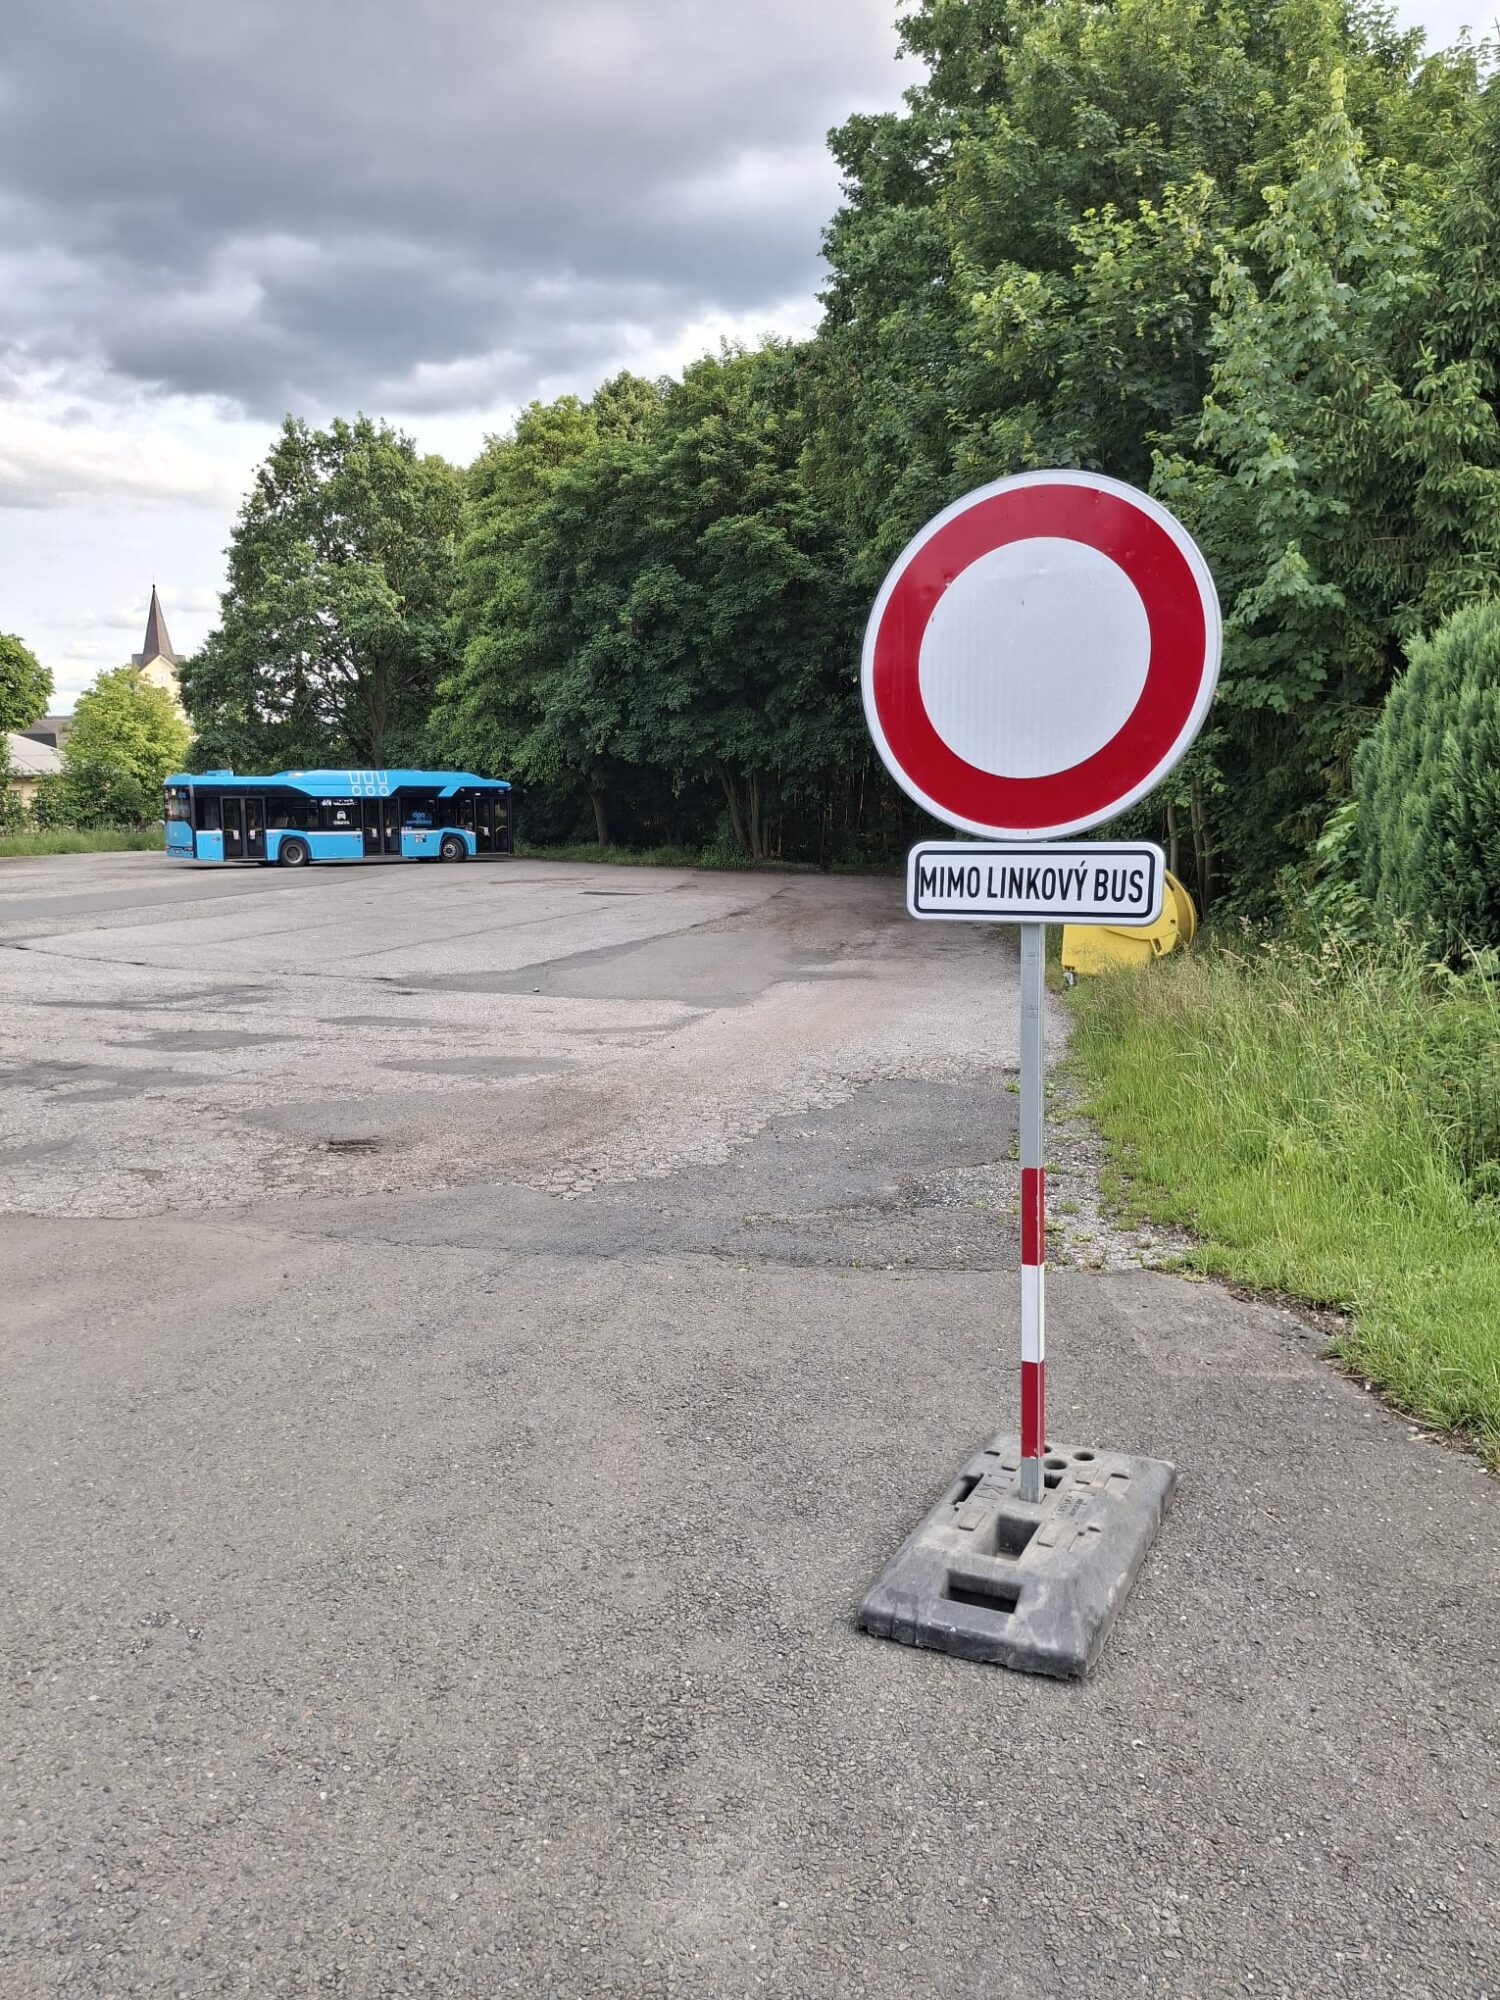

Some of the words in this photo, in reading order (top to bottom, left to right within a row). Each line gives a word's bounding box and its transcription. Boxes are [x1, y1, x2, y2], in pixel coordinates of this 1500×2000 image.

[920, 866, 981, 898] MIMO
[987, 861, 1087, 901] LINKOVÝ
[1094, 869, 1144, 902] BUS
